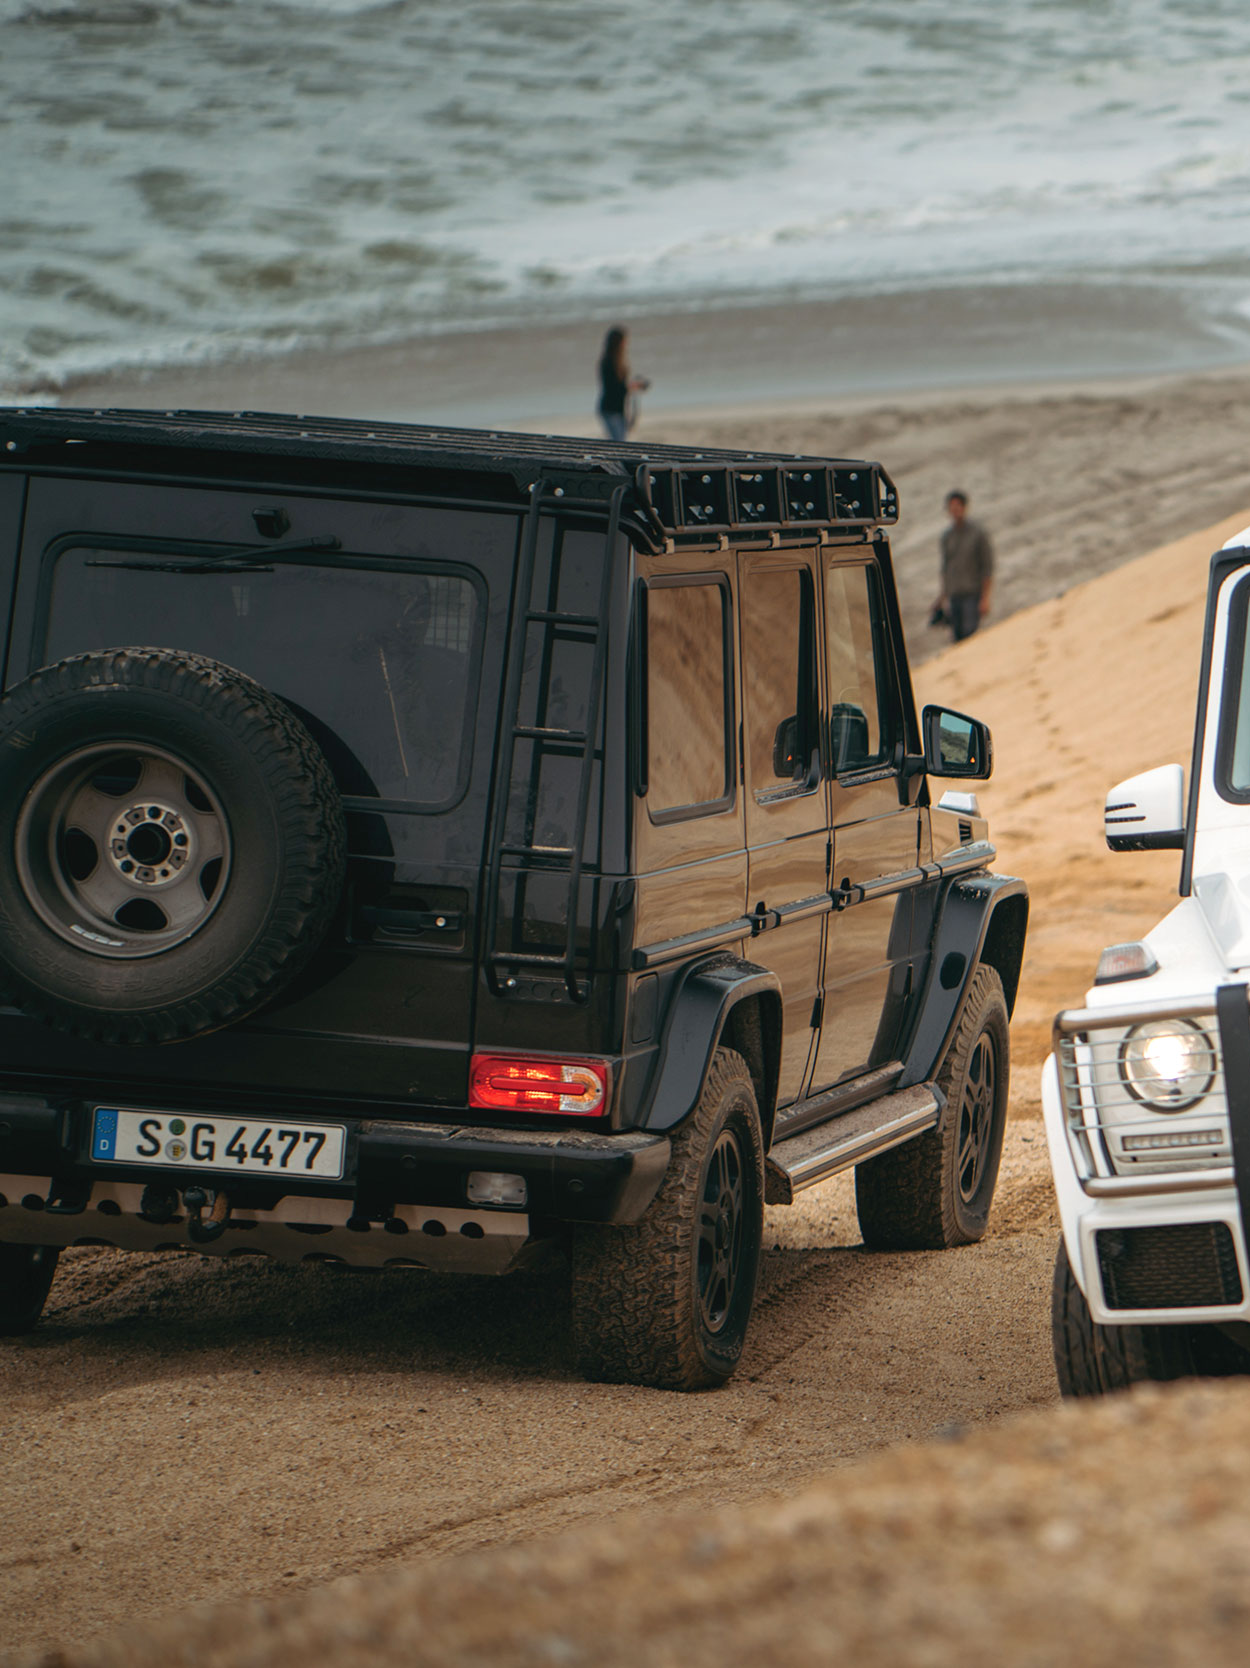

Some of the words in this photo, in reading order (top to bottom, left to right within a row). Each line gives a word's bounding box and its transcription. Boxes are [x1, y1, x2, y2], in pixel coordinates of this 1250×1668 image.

[100, 1139, 109, 1151] D
[136, 1119, 163, 1157] S
[225, 1126, 327, 1169] 4477
